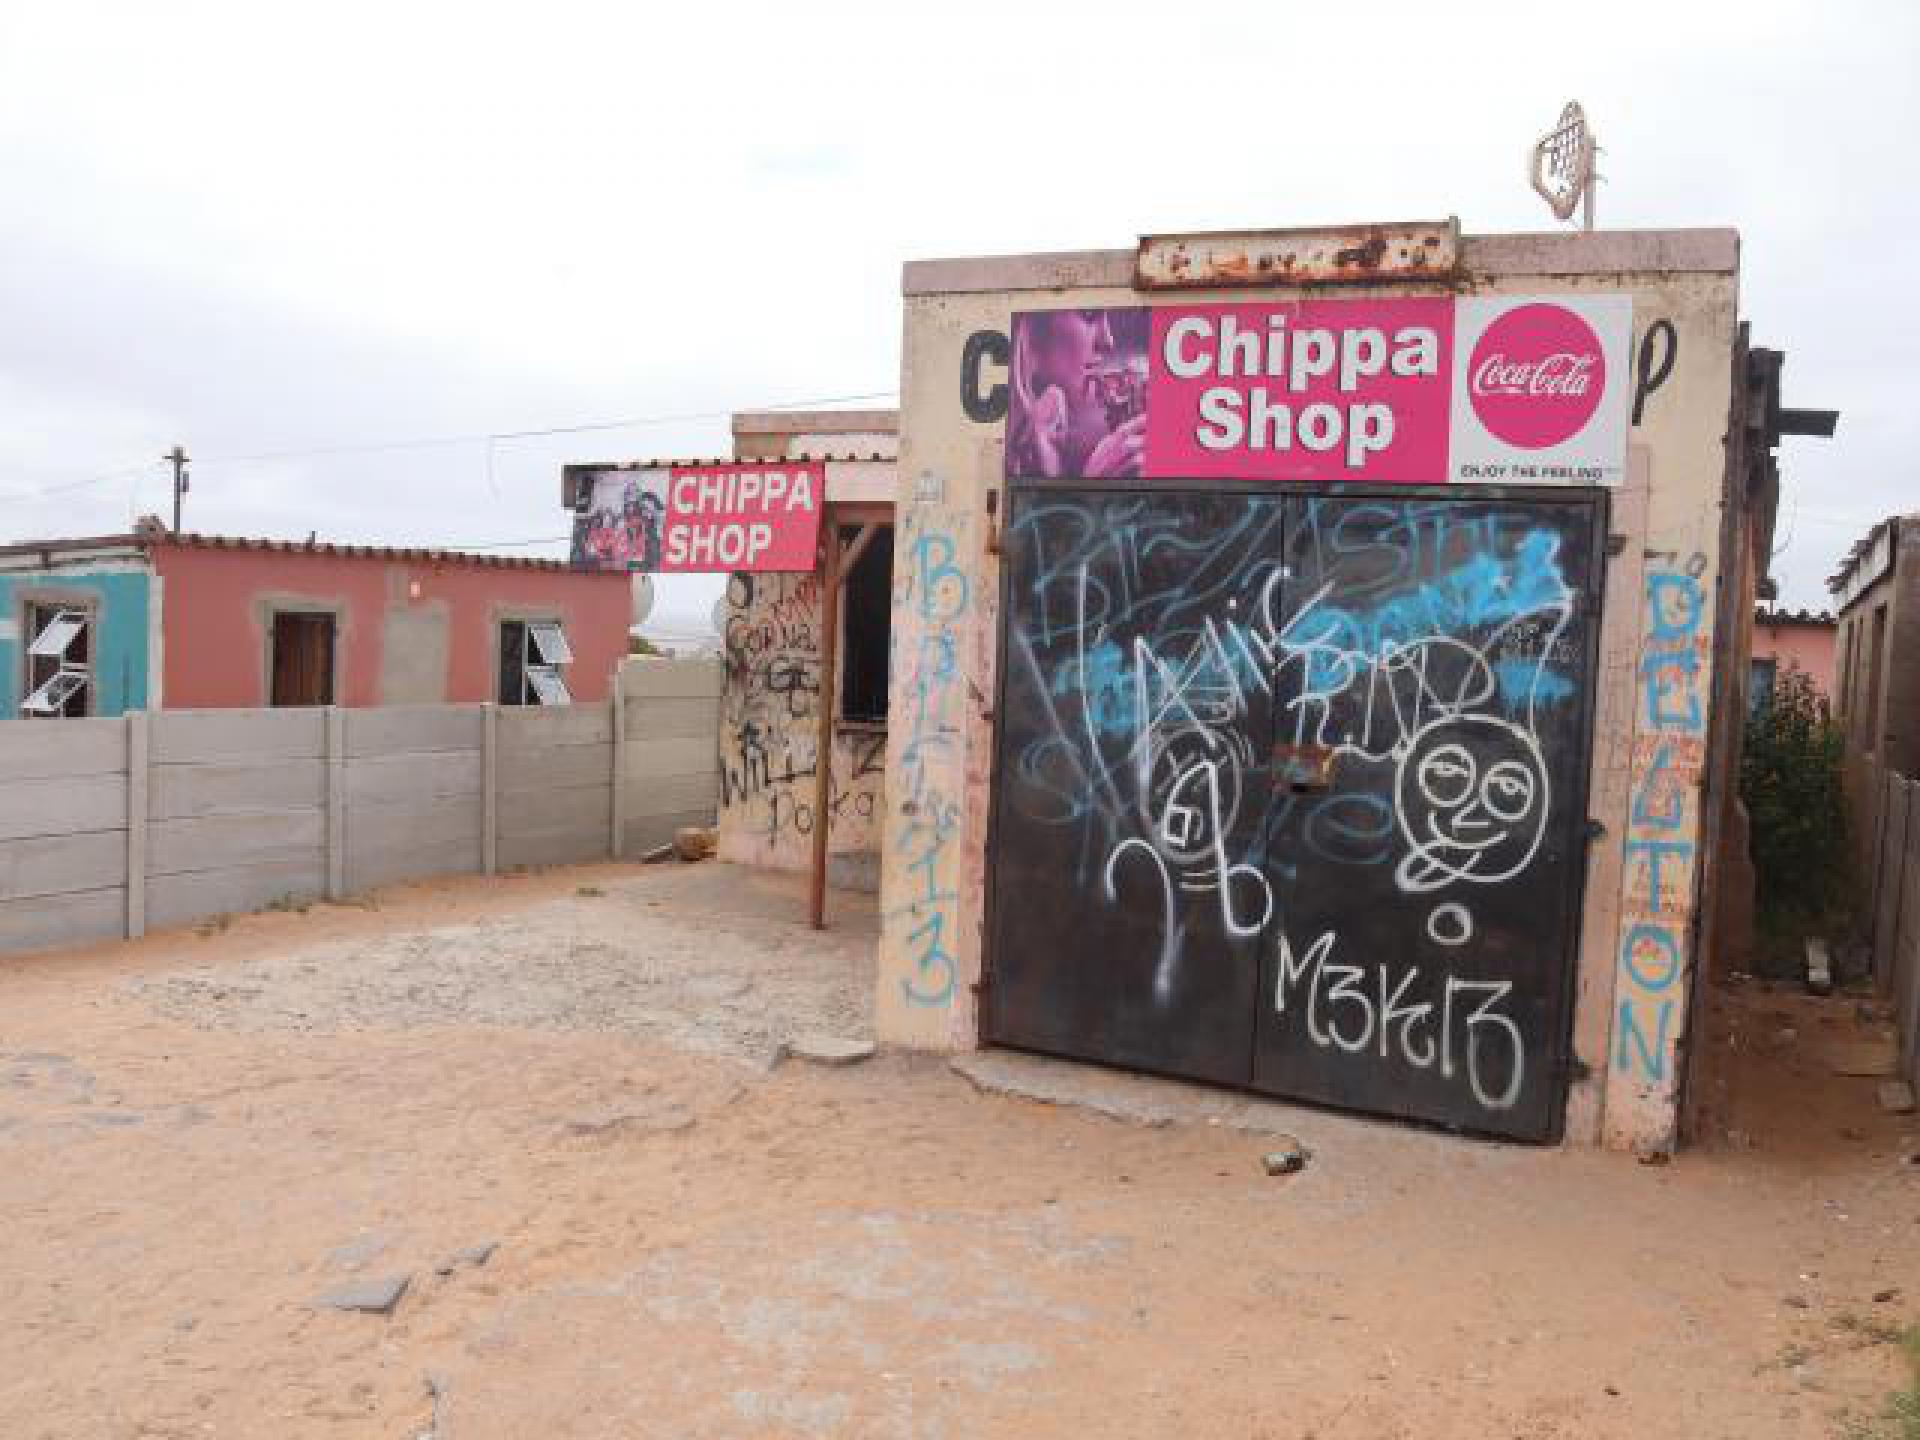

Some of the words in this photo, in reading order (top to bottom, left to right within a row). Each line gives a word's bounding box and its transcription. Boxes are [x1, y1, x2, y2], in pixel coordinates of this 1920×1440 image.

[1164, 314, 1439, 393] Chippa
[1195, 386, 1396, 468] Shop
[672, 471, 814, 515] CHIPPA
[1460, 464, 1506, 478] ENJOY
[1511, 464, 1537, 478] THE
[1541, 466, 1602, 480] FEELING
[667, 523, 773, 565] SHOP
